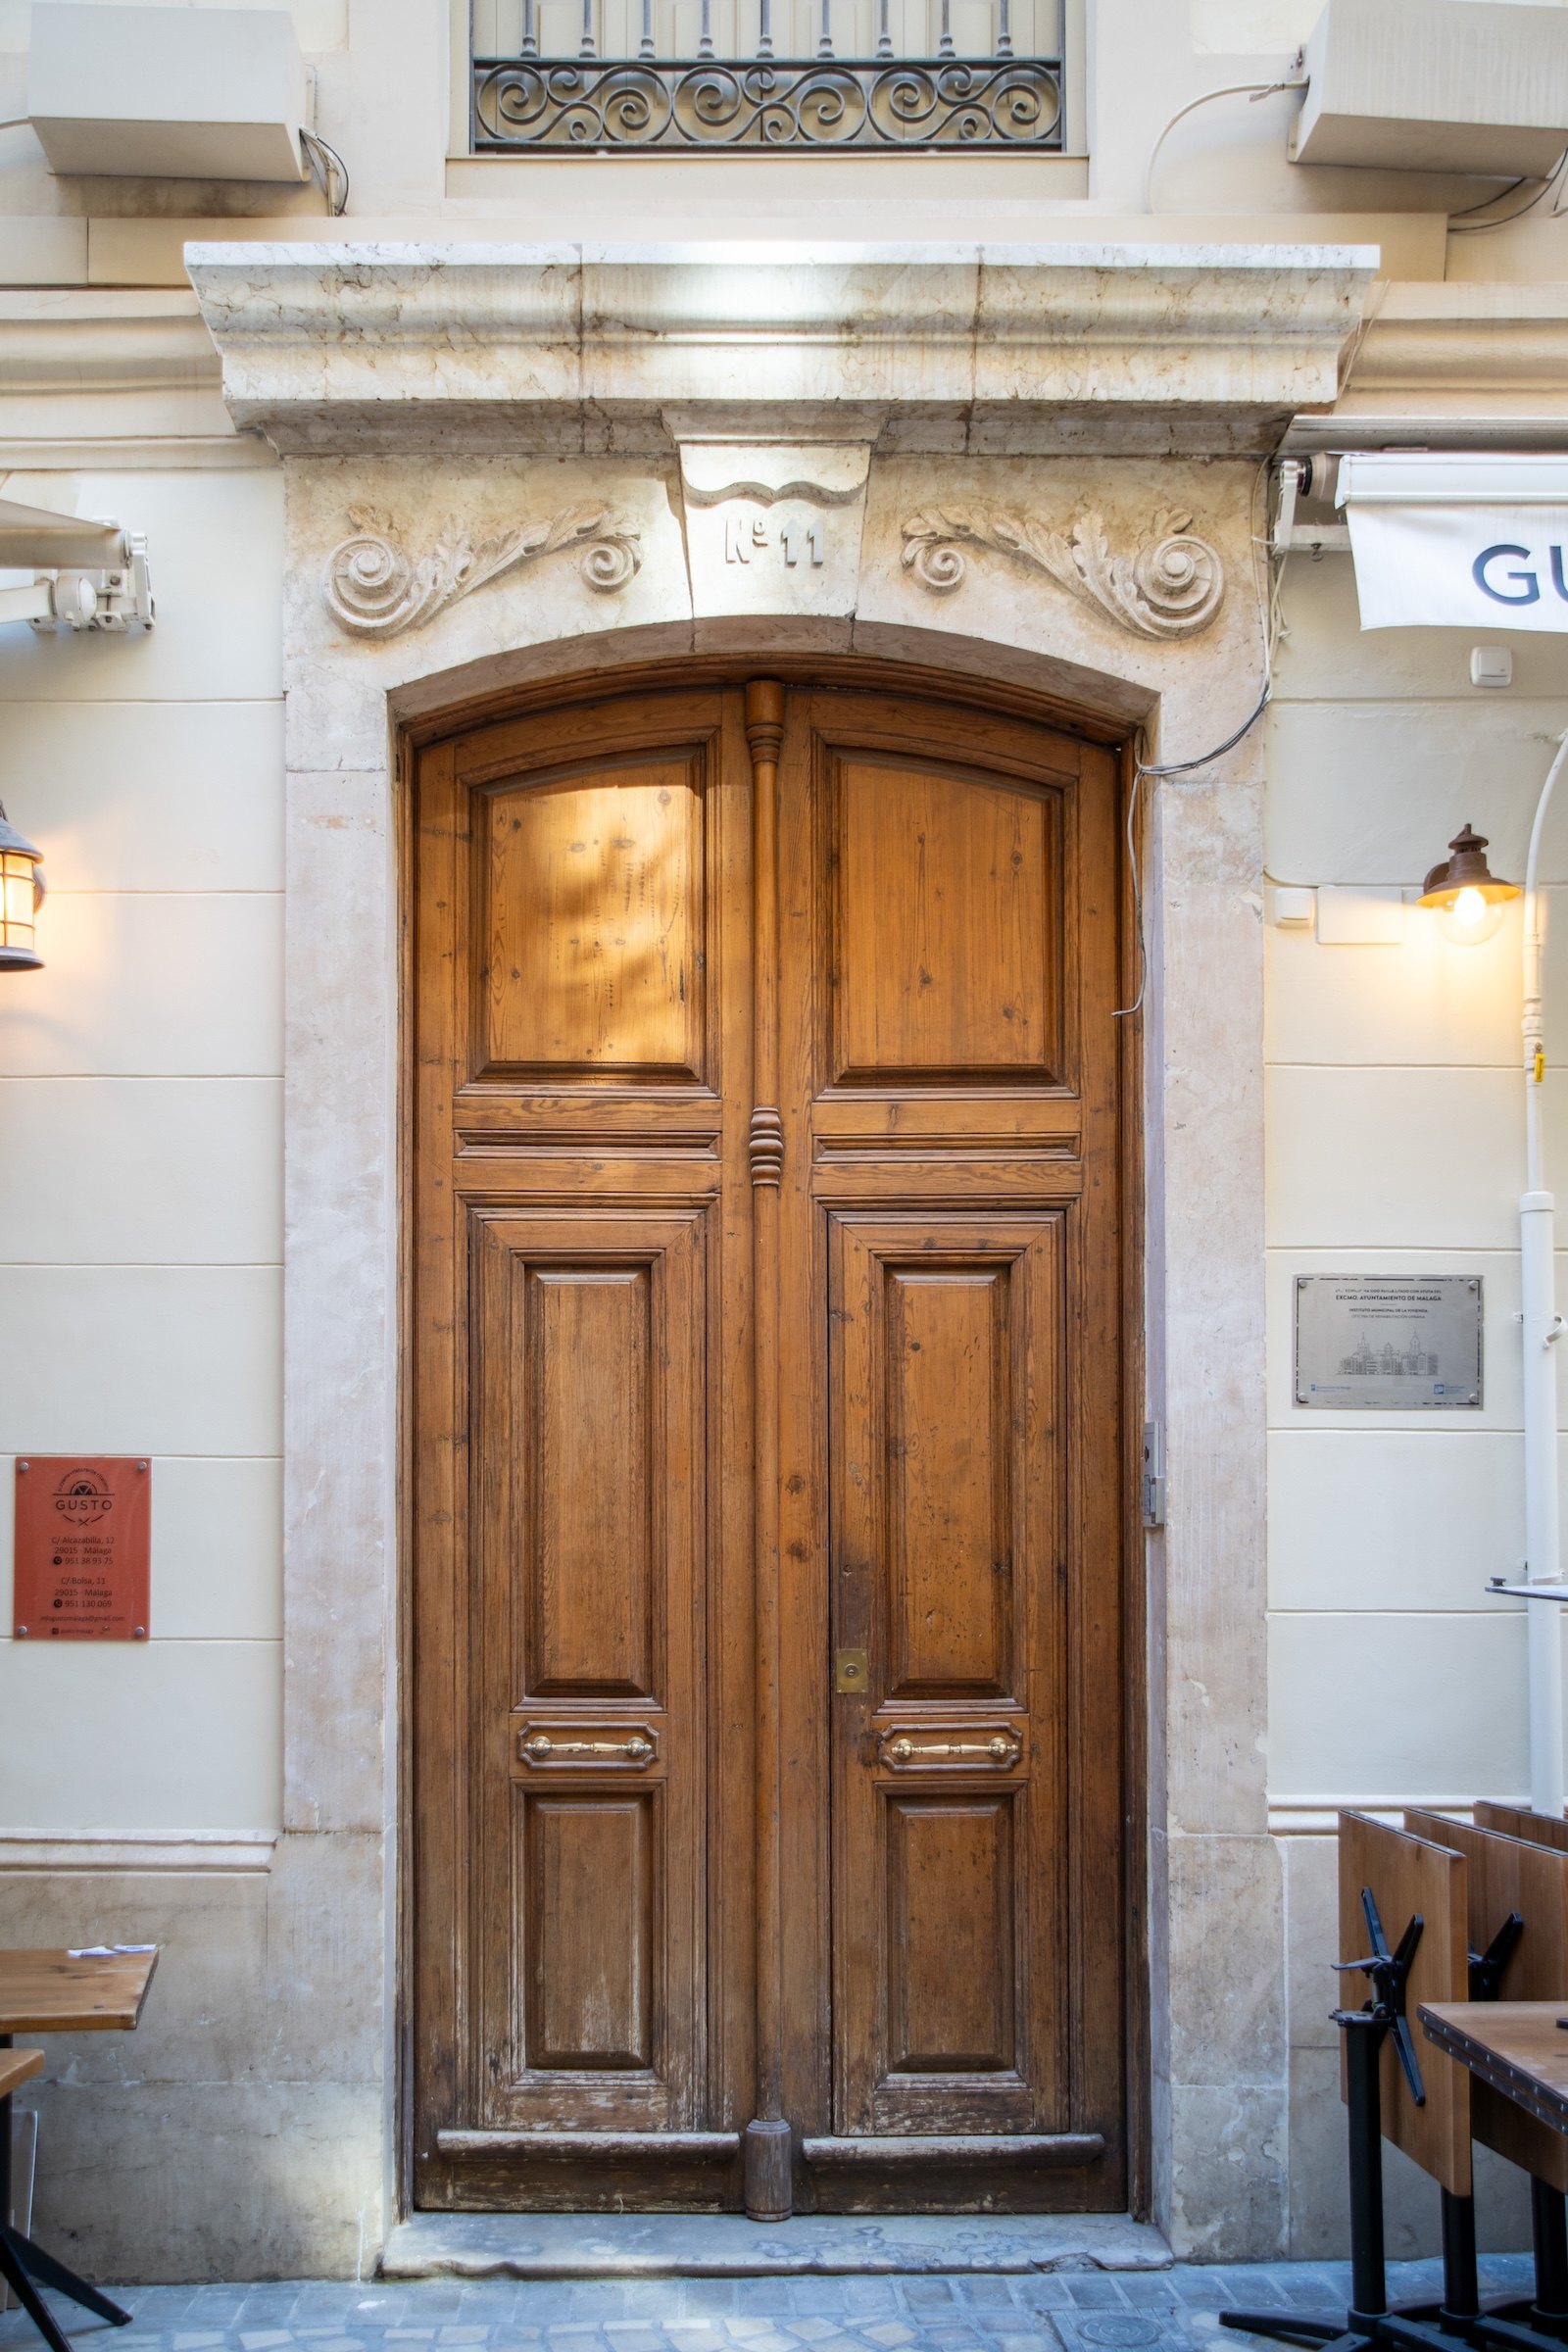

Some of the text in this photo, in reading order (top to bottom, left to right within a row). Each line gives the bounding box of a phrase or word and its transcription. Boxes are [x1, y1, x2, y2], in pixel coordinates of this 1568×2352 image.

[780, 518, 823, 568] 11
[56, 1499, 113, 1511] GUSTO
[62, 1536, 104, 1545] Alcazabilla,
[72, 1576, 95, 1586] Bolsa,
